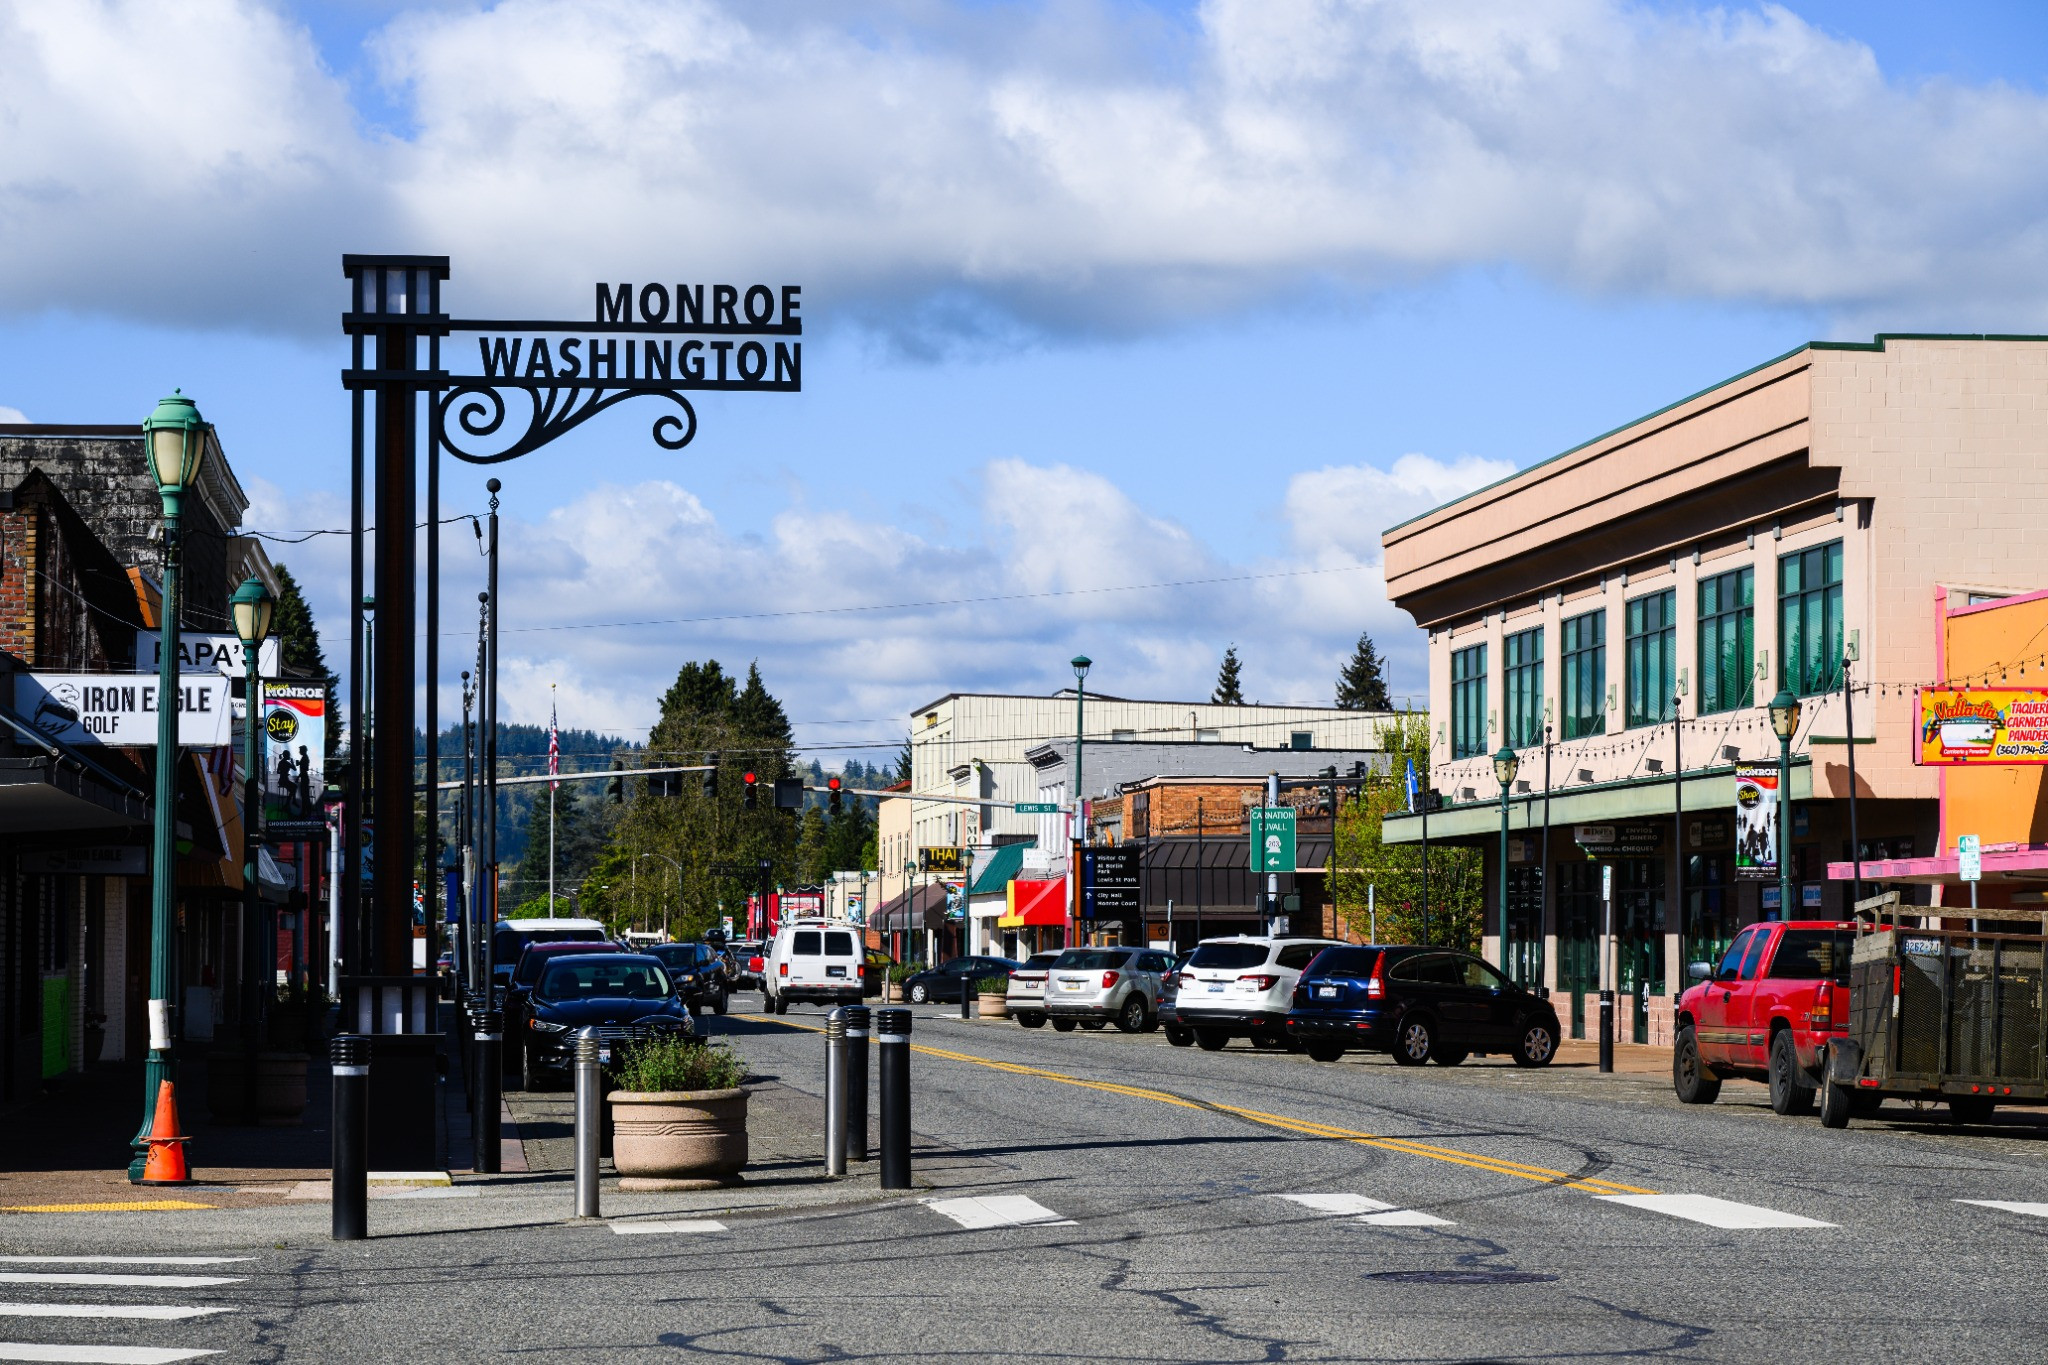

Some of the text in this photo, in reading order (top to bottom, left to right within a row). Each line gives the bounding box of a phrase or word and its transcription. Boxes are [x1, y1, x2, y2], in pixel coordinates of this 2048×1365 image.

[596, 283, 801, 325] MONROE
[479, 337, 801, 381] WASHINGTON
[265, 687, 324, 698] MONROE
[83, 686, 135, 713] IRON
[1935, 699, 1998, 720] Vallarta
[83, 716, 119, 734] GOLF
[268, 718, 297, 733] Stay
[1996, 744, 2020, 756] (360)
[1736, 768, 1778, 777] MONROE
[1739, 790, 1759, 800] Shop
[1020, 804, 1039, 812] LEWIS
[1251, 811, 1294, 820] CARNATION
[1258, 823, 1287, 831] DUVALL
[929, 848, 957, 861] THAI
